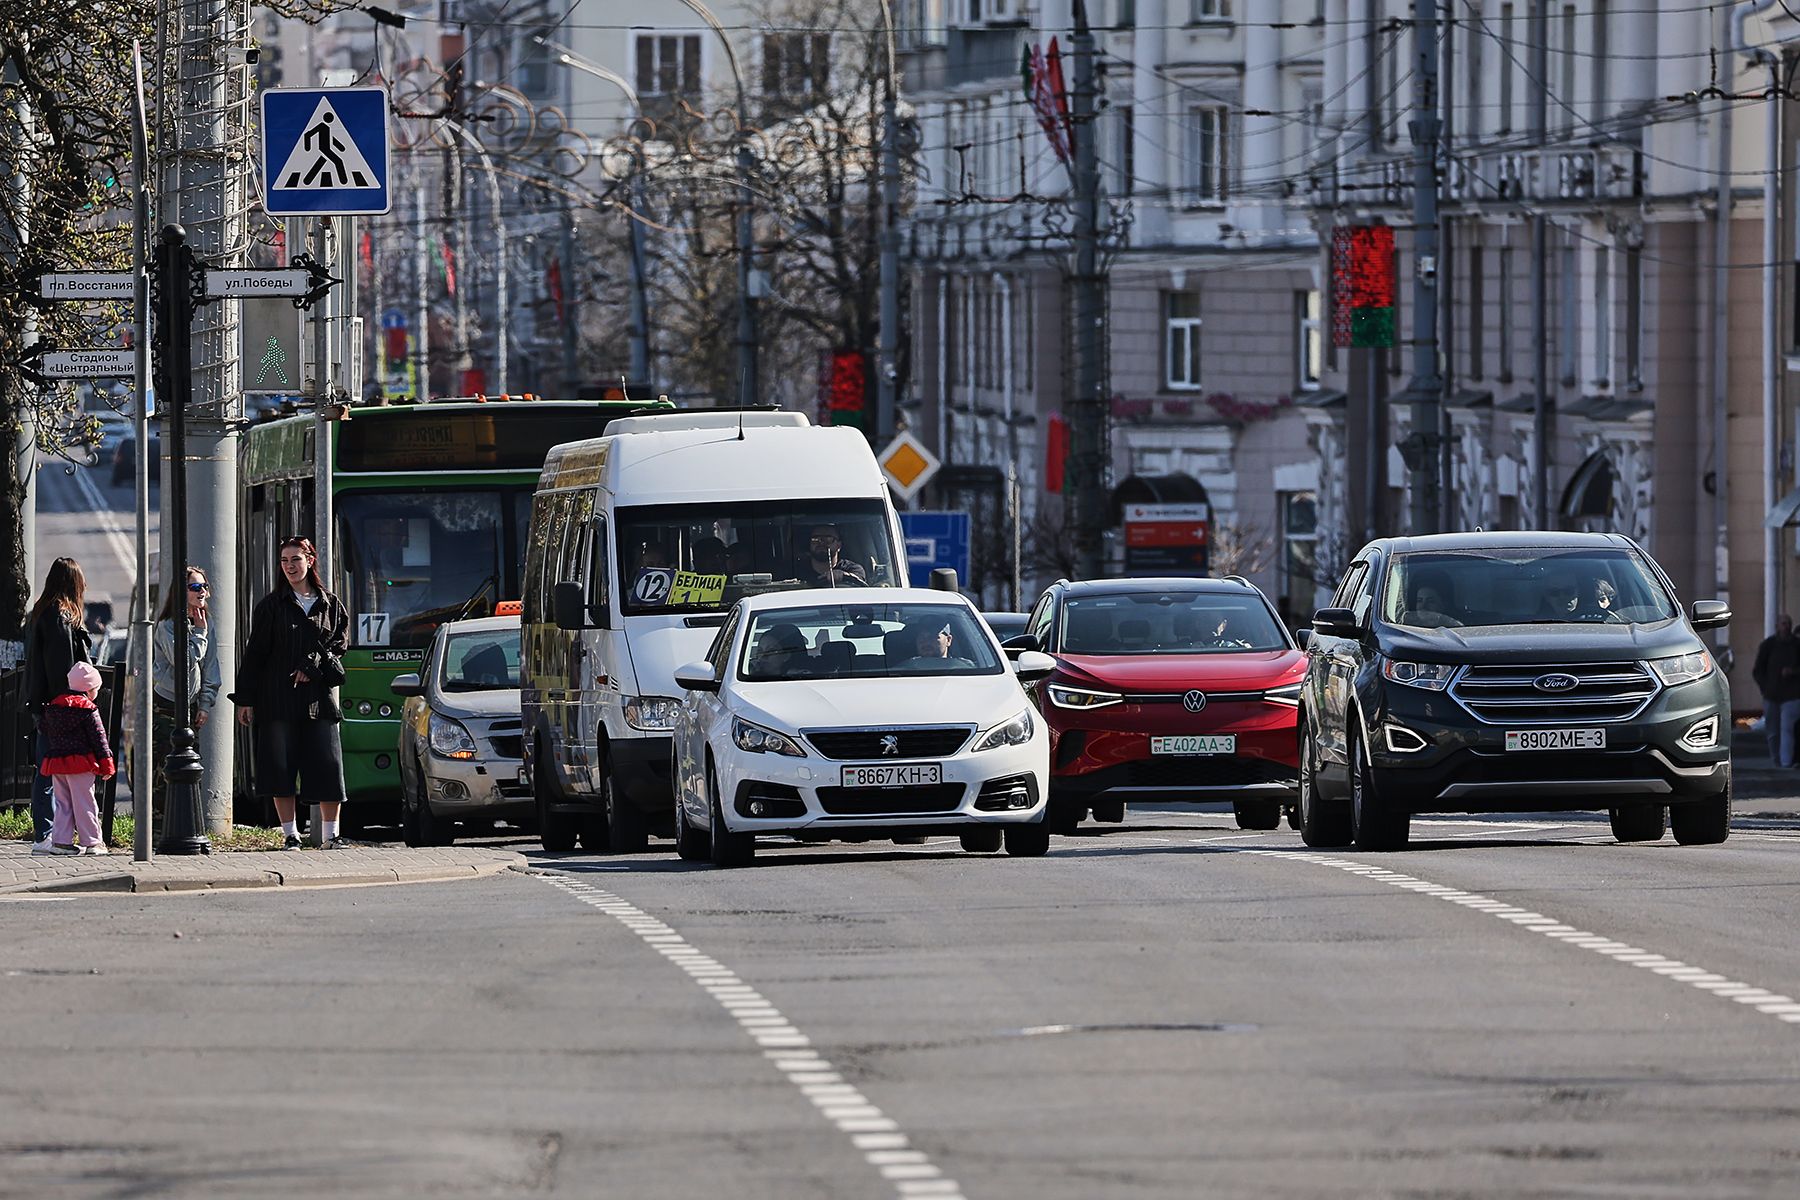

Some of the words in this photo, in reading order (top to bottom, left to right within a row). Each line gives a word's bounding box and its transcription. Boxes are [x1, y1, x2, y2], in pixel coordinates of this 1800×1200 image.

[49, 280, 133, 291] пл.Восстания
[225, 277, 293, 290] ул.Победы
[70, 353, 119, 363] Стадион
[640, 574, 666, 600] 12
[676, 574, 722, 592] БЕЛИЦА
[361, 615, 386, 643] 17
[1543, 677, 1569, 688] Ford
[1509, 741, 1518, 749] BY
